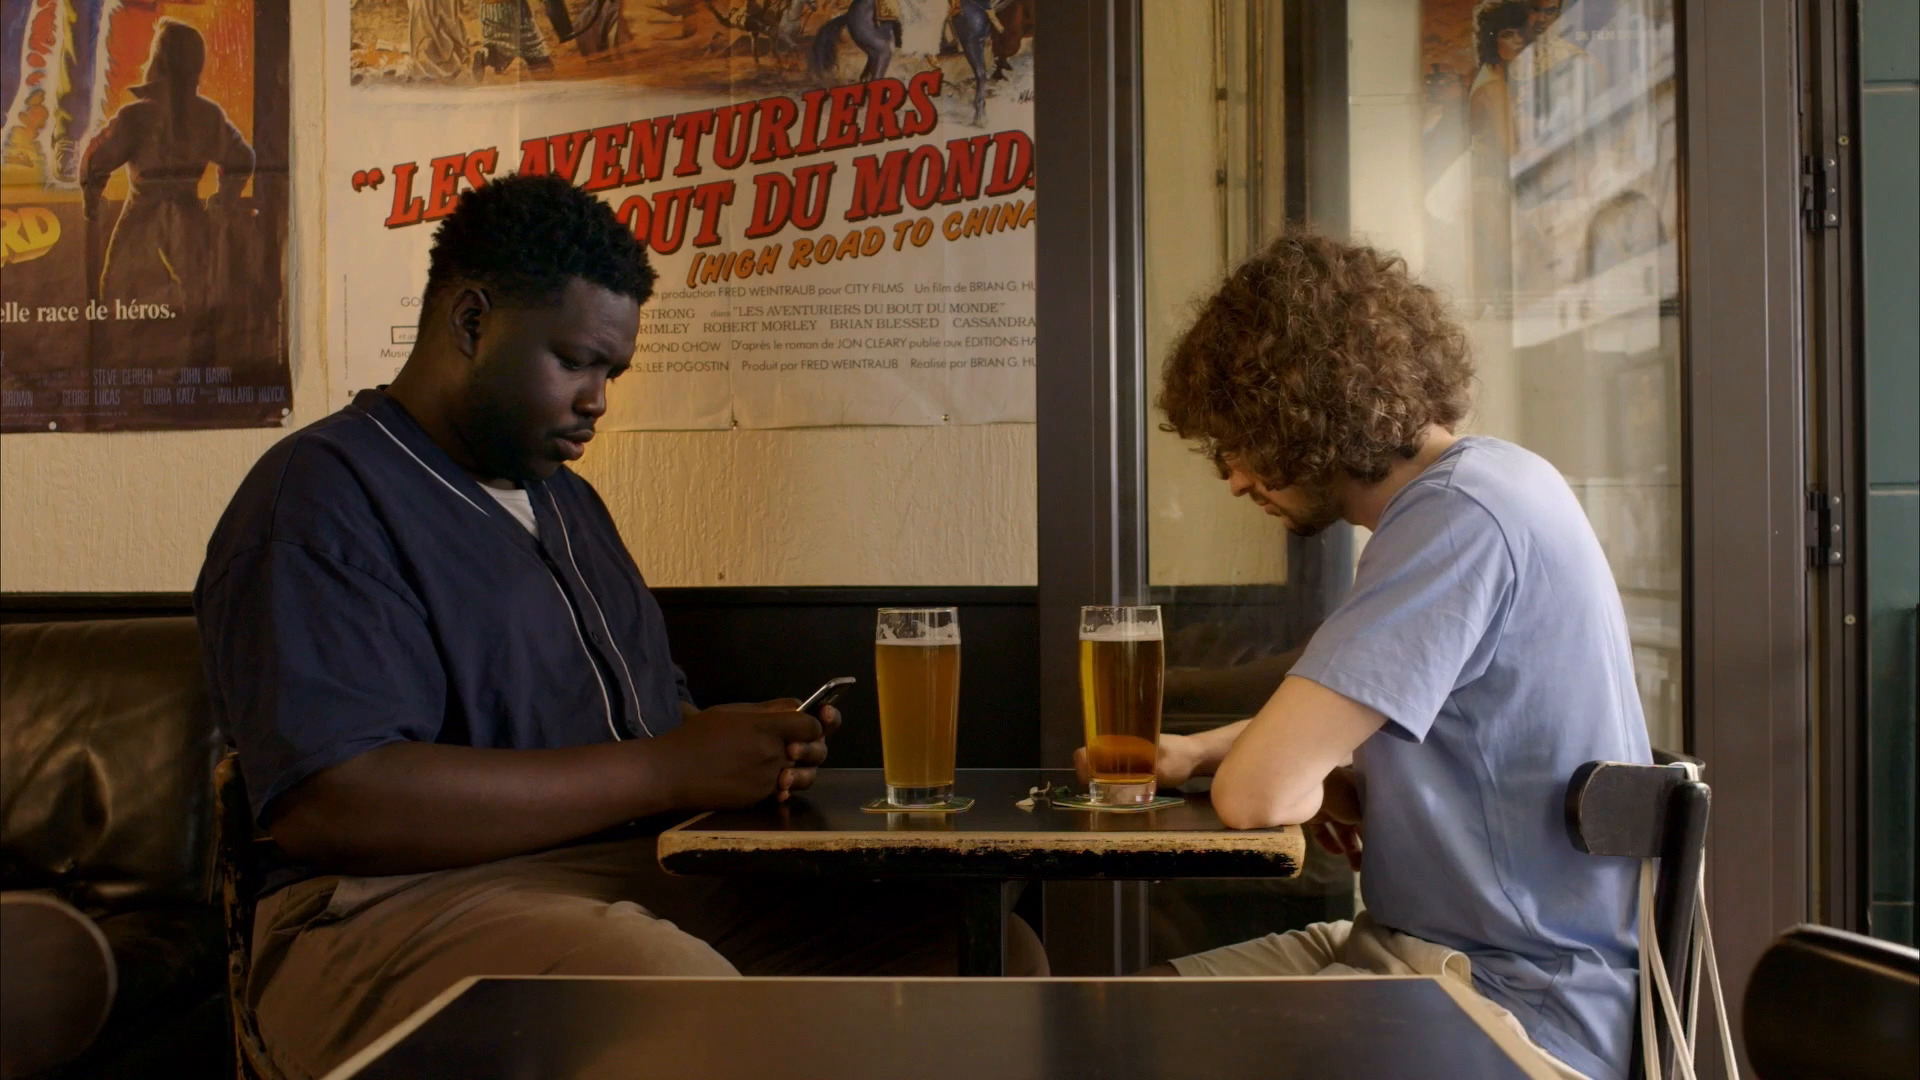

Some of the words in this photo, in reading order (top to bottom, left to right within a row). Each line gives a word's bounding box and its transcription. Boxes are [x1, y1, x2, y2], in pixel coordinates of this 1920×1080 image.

[616, 180, 735, 254] OUT
[744, 161, 837, 239] DU
[845, 129, 1036, 223] MOND
[0, 207, 61, 268] RD
[788, 225, 886, 270] ROAD
[892, 216, 933, 252] TO
[661, 288, 715, 300] production
[718, 286, 746, 297] FRED
[750, 285, 816, 296] WEINTRAUB
[818, 286, 842, 297] pour
[844, 284, 870, 294] CITY
[872, 283, 904, 294] FILMS
[914, 283, 930, 294] Un
[932, 282, 952, 293] film
[953, 282, 967, 293] de
[969, 281, 1004, 292] BRIAN
[37, 305, 79, 322] race
[85, 299, 108, 321] de
[116, 299, 176, 320] héros.
[640, 307, 696, 319] STRONG
[766, 304, 861, 316] AVENTURIERS
[864, 304, 883, 315] DU
[886, 303, 924, 314] BOUT
[926, 303, 946, 314] DU
[640, 322, 690, 334] RIMLEY
[703, 321, 760, 333] ROBERT
[761, 320, 818, 332] MORLEY
[830, 318, 873, 330] BRIAN
[876, 318, 940, 329] BLESSED
[952, 316, 1036, 328] CASSANDRA
[635, 341, 680, 353] YMOND
[682, 341, 721, 352] CHOW
[774, 339, 783, 350] le
[785, 341, 819, 350] roman
[821, 338, 834, 349] de
[837, 338, 862, 349] JON
[865, 338, 907, 349] CLEARY
[944, 339, 962, 348] aux
[646, 361, 664, 373] LEE
[666, 361, 730, 373] POGOSTIN
[742, 359, 778, 371] Produit
[780, 362, 799, 374] par
[801, 359, 828, 370] FRED
[832, 358, 898, 370] WEINTRAUB
[949, 360, 967, 371] par
[970, 357, 1004, 368] BRIAN
[93, 368, 117, 386] STEVE
[179, 367, 201, 385] JOHN
[94, 388, 121, 406] LUCAS
[143, 387, 172, 405] GLORIA
[176, 386, 196, 404] KATZ
[217, 386, 254, 404] WILLARD
